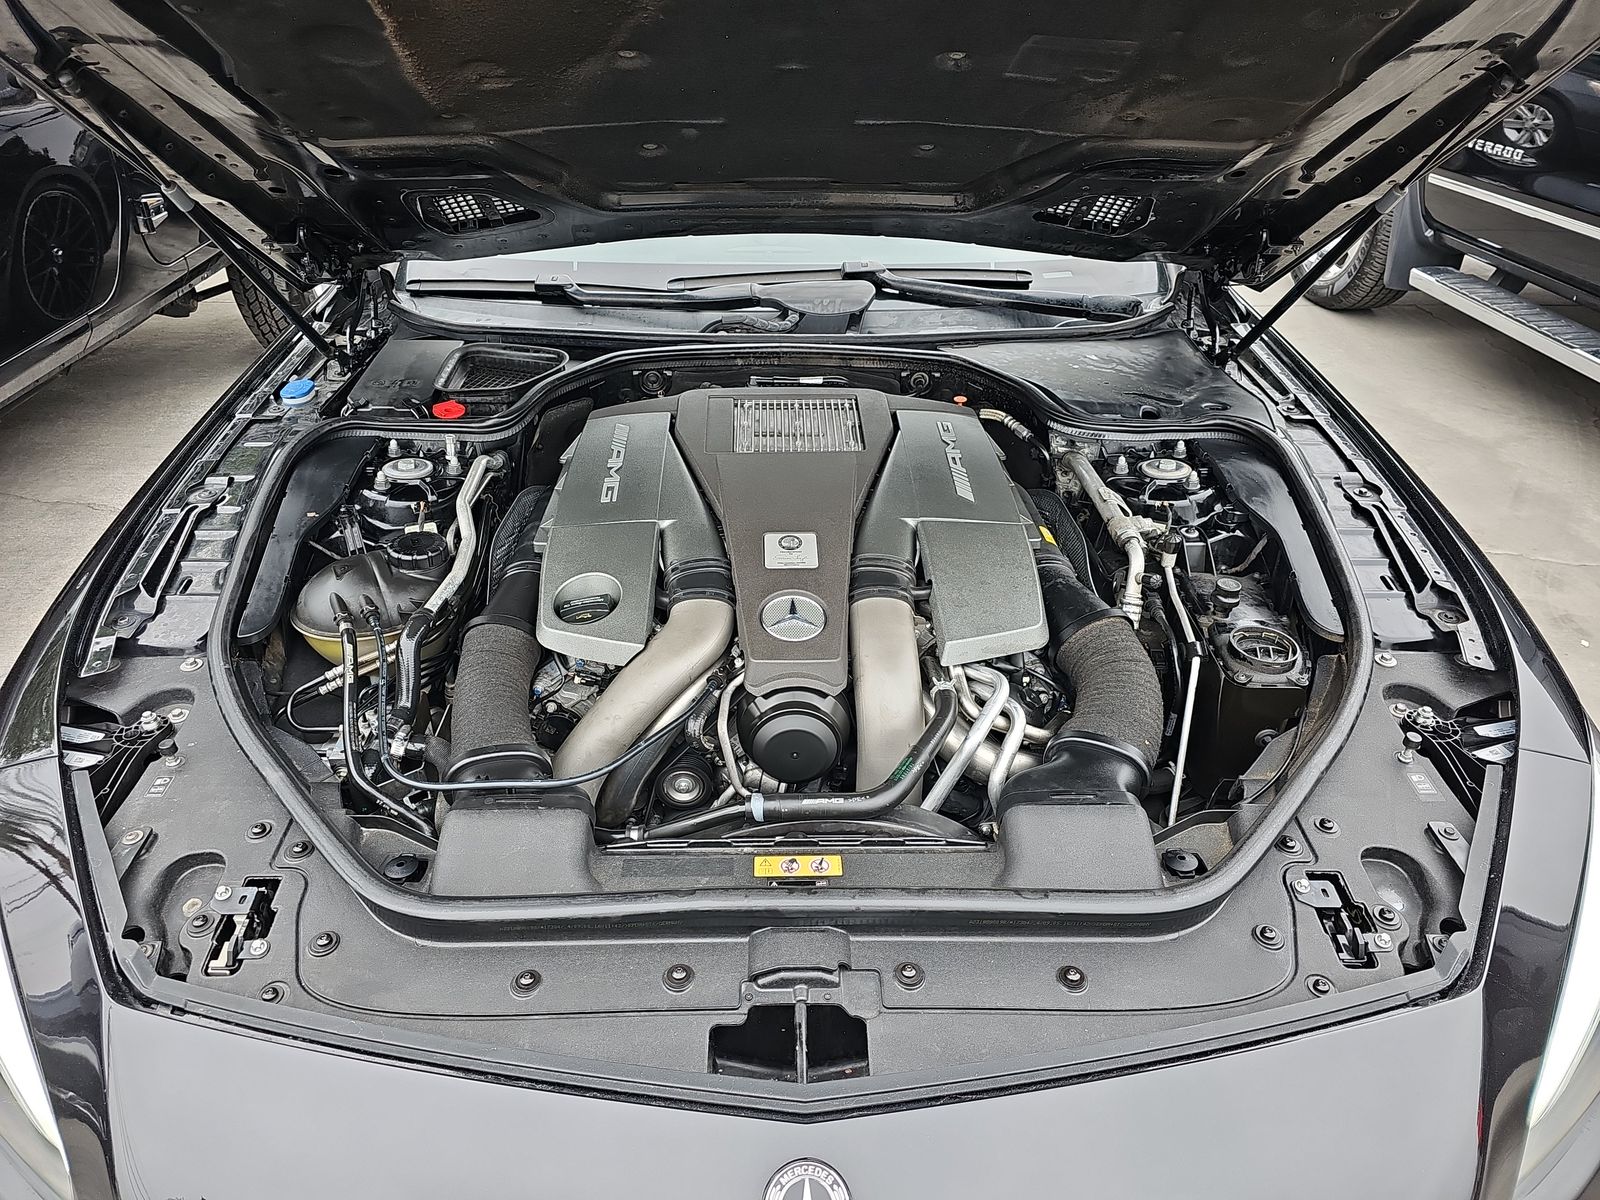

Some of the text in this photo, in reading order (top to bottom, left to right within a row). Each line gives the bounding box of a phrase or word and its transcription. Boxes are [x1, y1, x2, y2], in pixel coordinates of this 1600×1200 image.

[601, 445, 626, 503] AMG
[936, 421, 967, 474] AMG
[780, 1165, 834, 1186] MERCEDES
